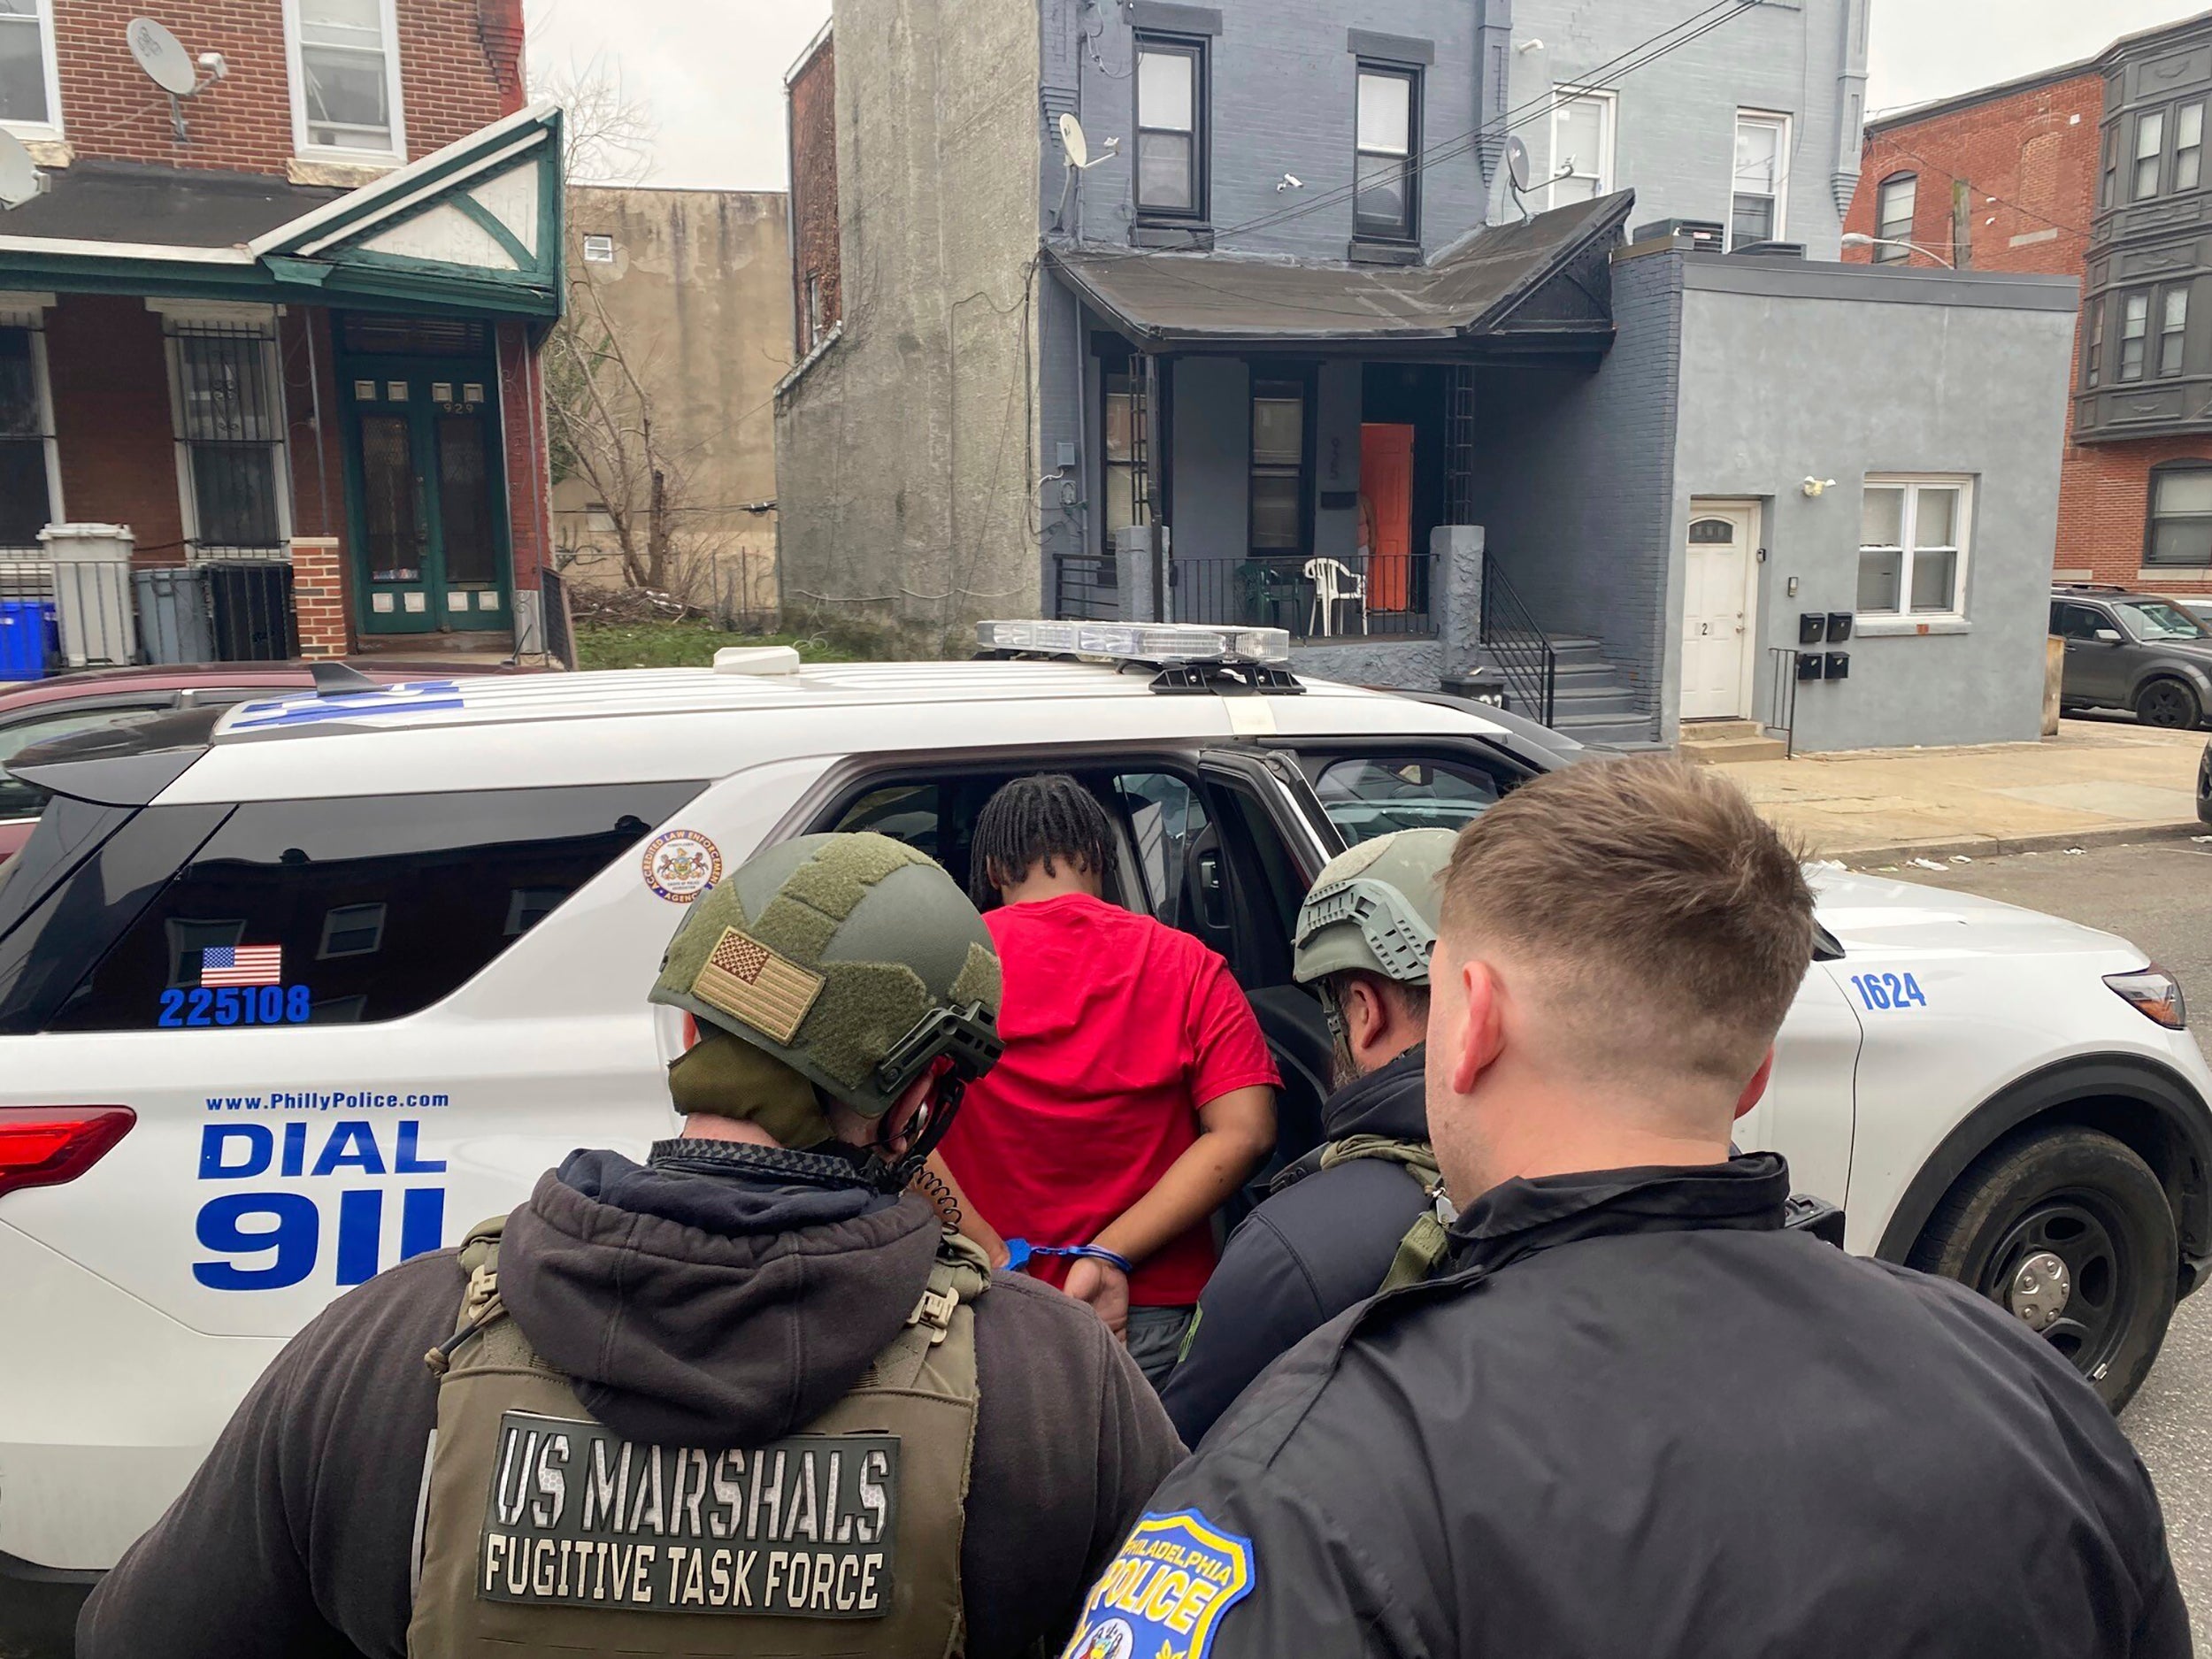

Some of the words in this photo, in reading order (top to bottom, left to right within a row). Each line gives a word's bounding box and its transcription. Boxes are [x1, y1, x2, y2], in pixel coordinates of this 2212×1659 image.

[443, 403, 473, 414] 929
[1701, 622, 1709, 635] 2
[643, 839, 664, 889] ACCREDITED
[664, 832, 686, 841] LAW
[687, 832, 721, 885] ENFORCEMEN
[664, 893, 699, 902] AGENC
[157, 984, 311, 1027] 225108
[1850, 972, 1927, 1010] 1624
[206, 1091, 449, 1111] www.PhillyPolice.com
[197, 1120, 448, 1180] DIAL
[192, 1187, 445, 1292] 911
[494, 1427, 572, 1529] US
[580, 1437, 889, 1544] MARSHALS
[485, 1532, 657, 1603] FUGITIVE
[667, 1546, 758, 1608] TASK
[764, 1551, 884, 1610] FORCE
[1122, 1539, 1233, 1586] PHILADELPHIA
[1091, 1557, 1220, 1635] POLICE
